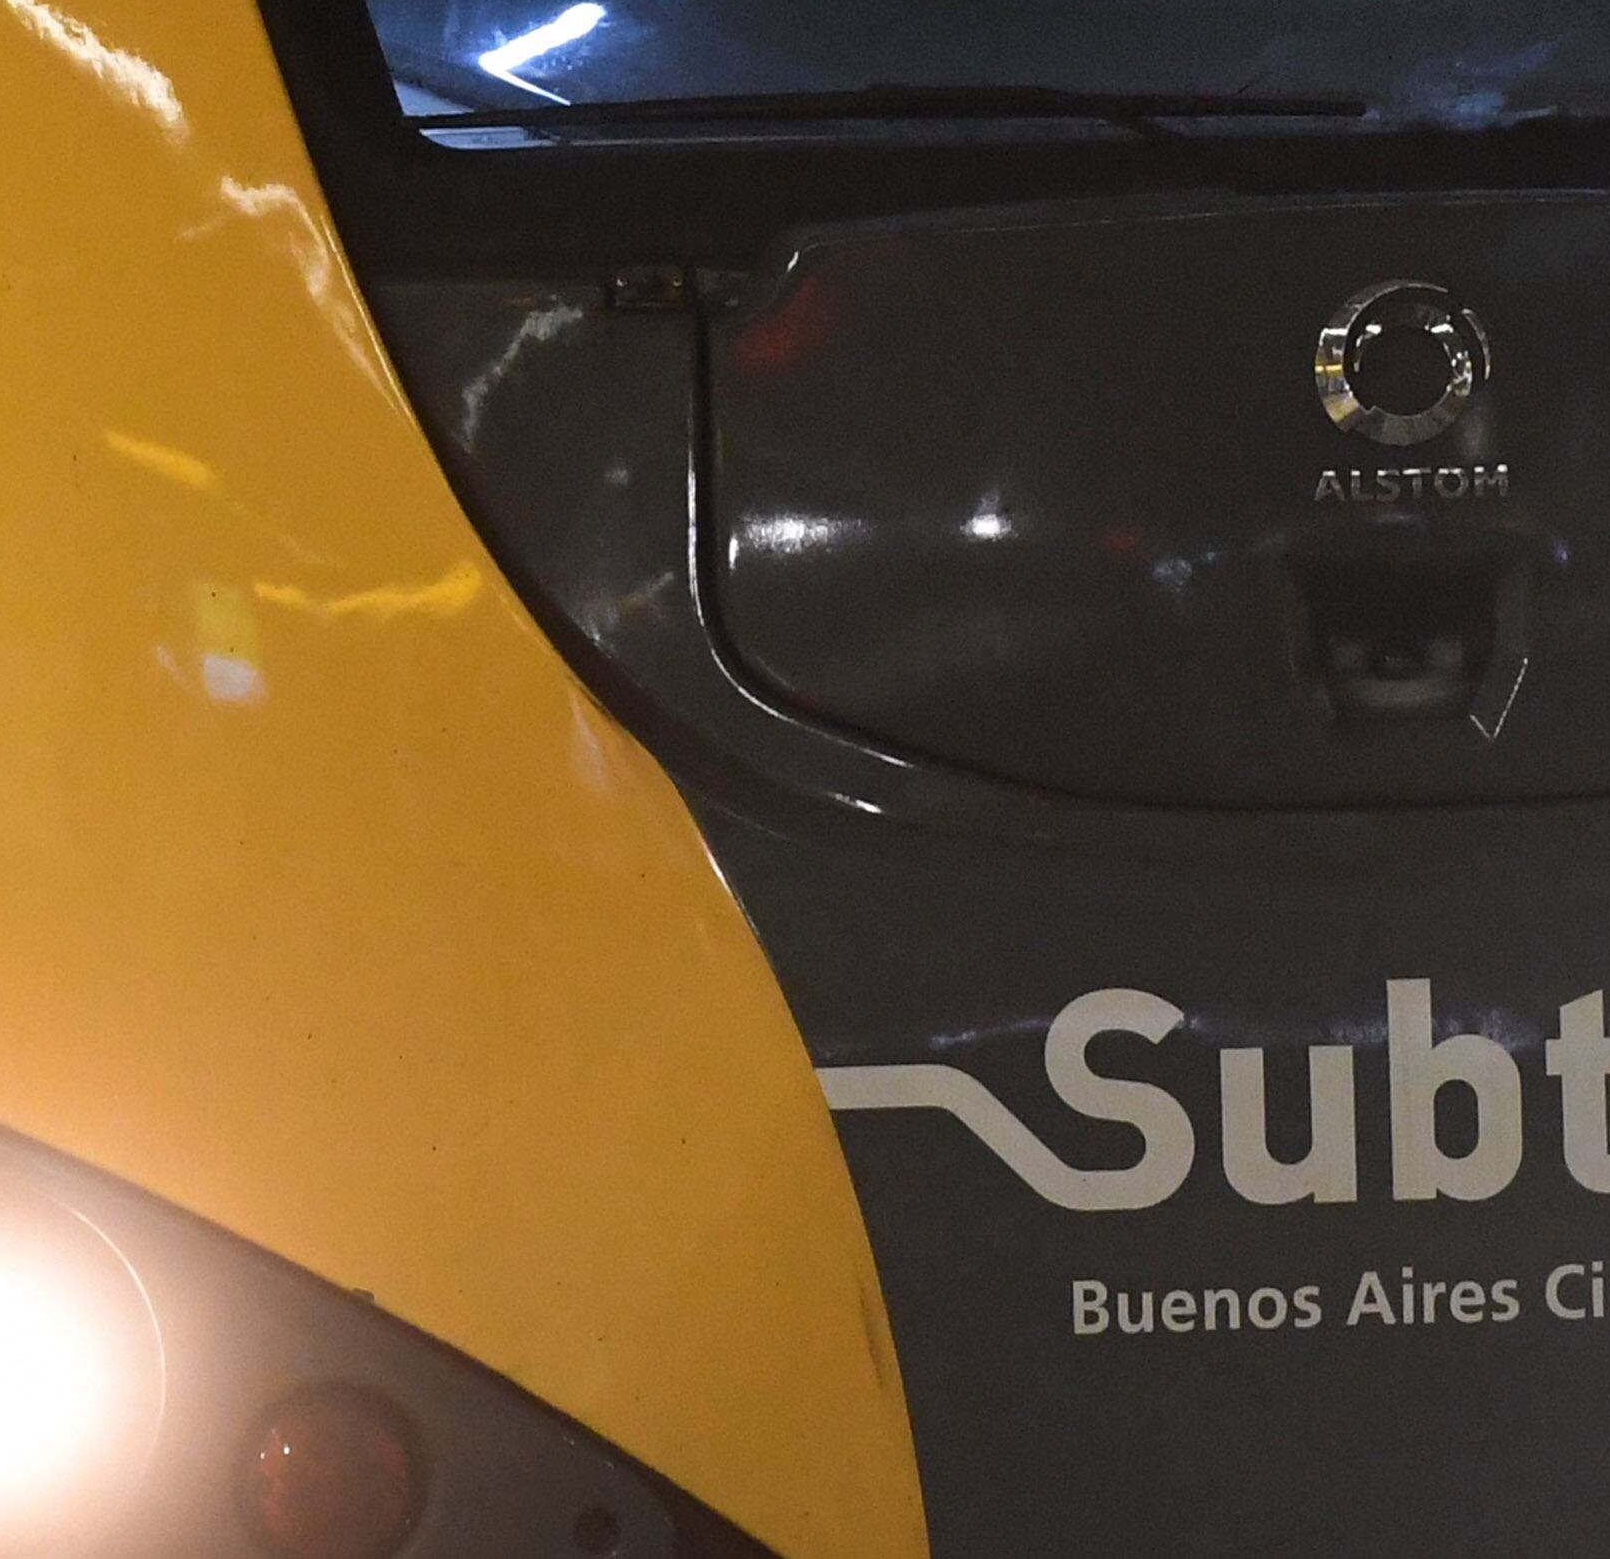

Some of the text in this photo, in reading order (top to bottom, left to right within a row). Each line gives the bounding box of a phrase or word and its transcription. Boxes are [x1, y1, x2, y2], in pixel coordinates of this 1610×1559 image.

[1313, 463, 1510, 503] ALSTOM
[1074, 1281, 1323, 1335] Buenos
[1348, 1268, 1521, 1326] Aires
